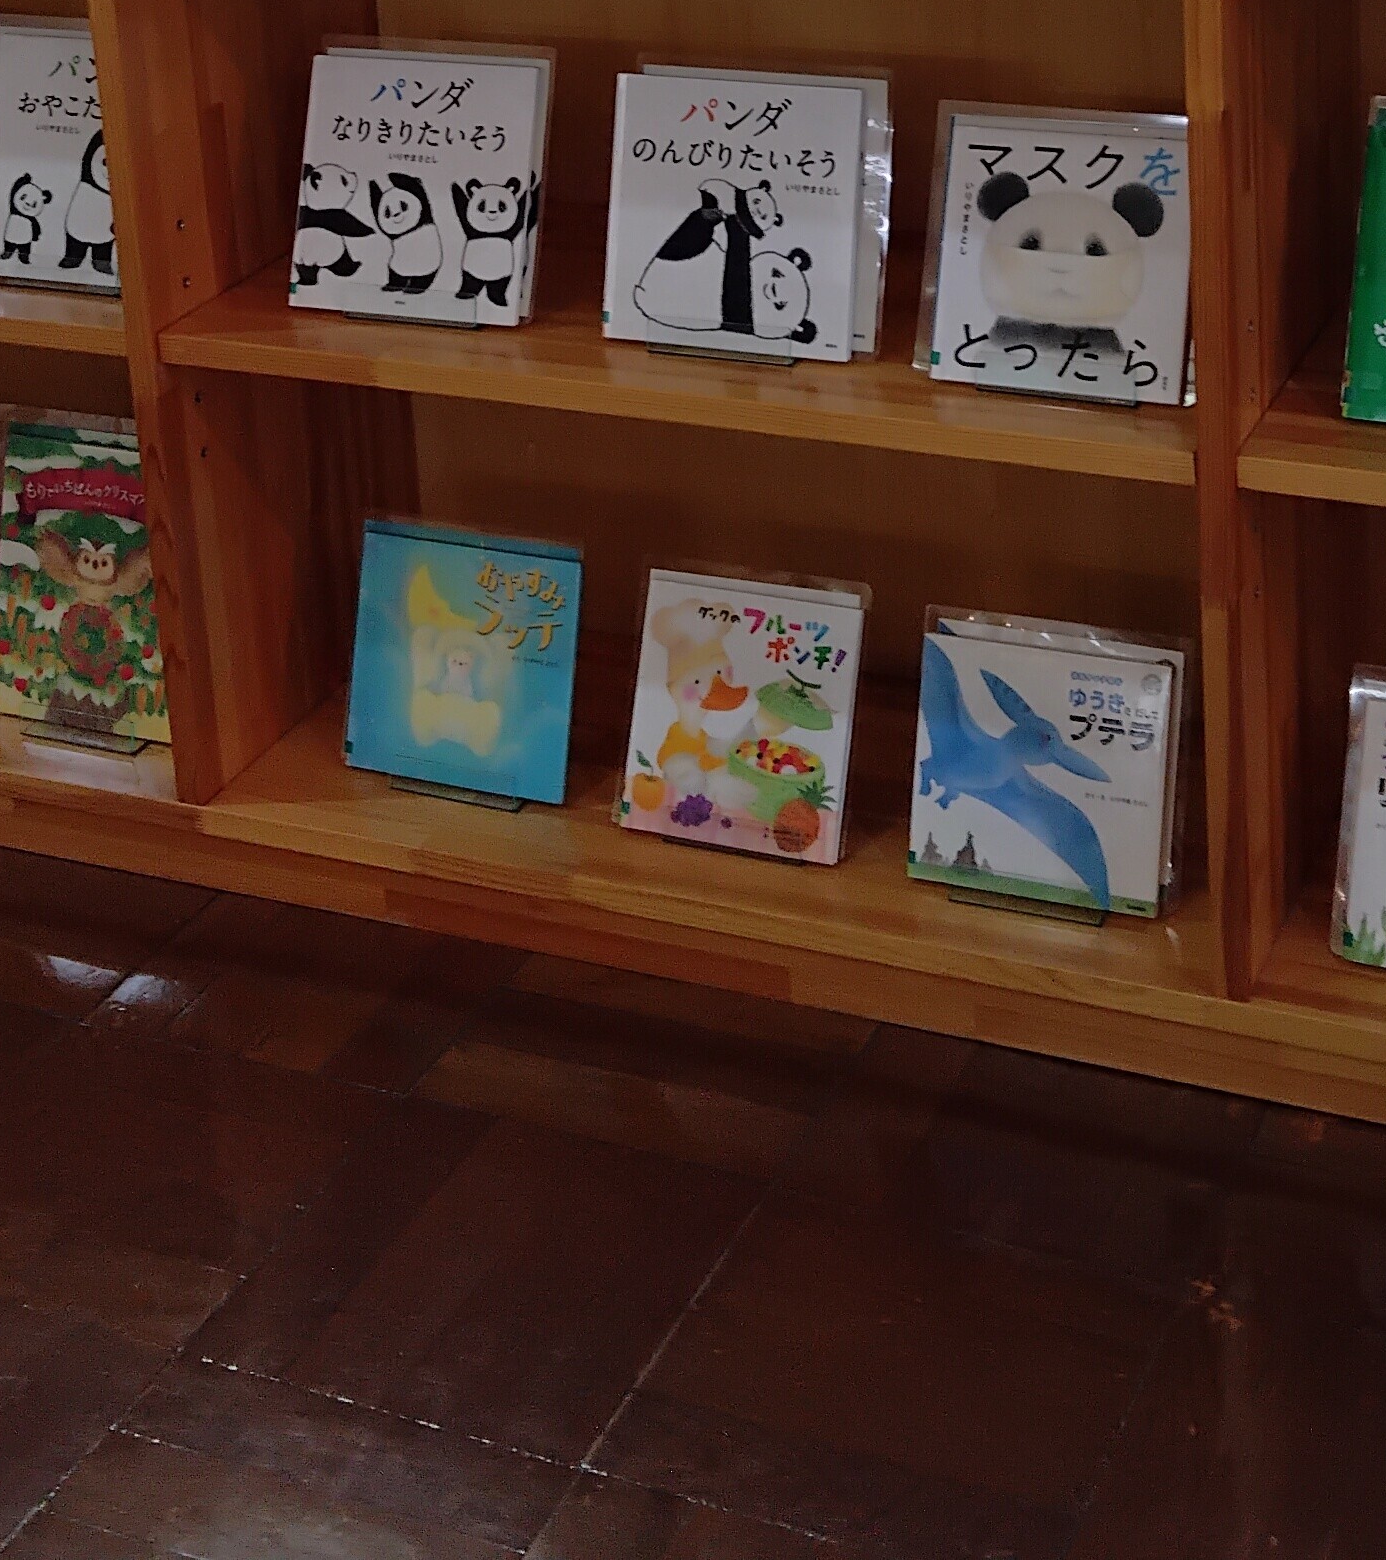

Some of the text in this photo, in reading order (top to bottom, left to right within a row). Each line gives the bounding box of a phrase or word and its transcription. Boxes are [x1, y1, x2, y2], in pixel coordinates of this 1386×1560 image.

[370, 77, 475, 115] パンダ
[680, 96, 793, 137] パンダ
[331, 114, 507, 153] なりきりたいそう
[631, 137, 838, 179] のんびりたいそう
[967, 143, 1181, 197] マスクを
[953, 323, 1159, 387] とったら
[476, 561, 566, 612] おやすみ
[743, 607, 830, 642] フルーツ
[1068, 712, 1156, 752] プテラ
